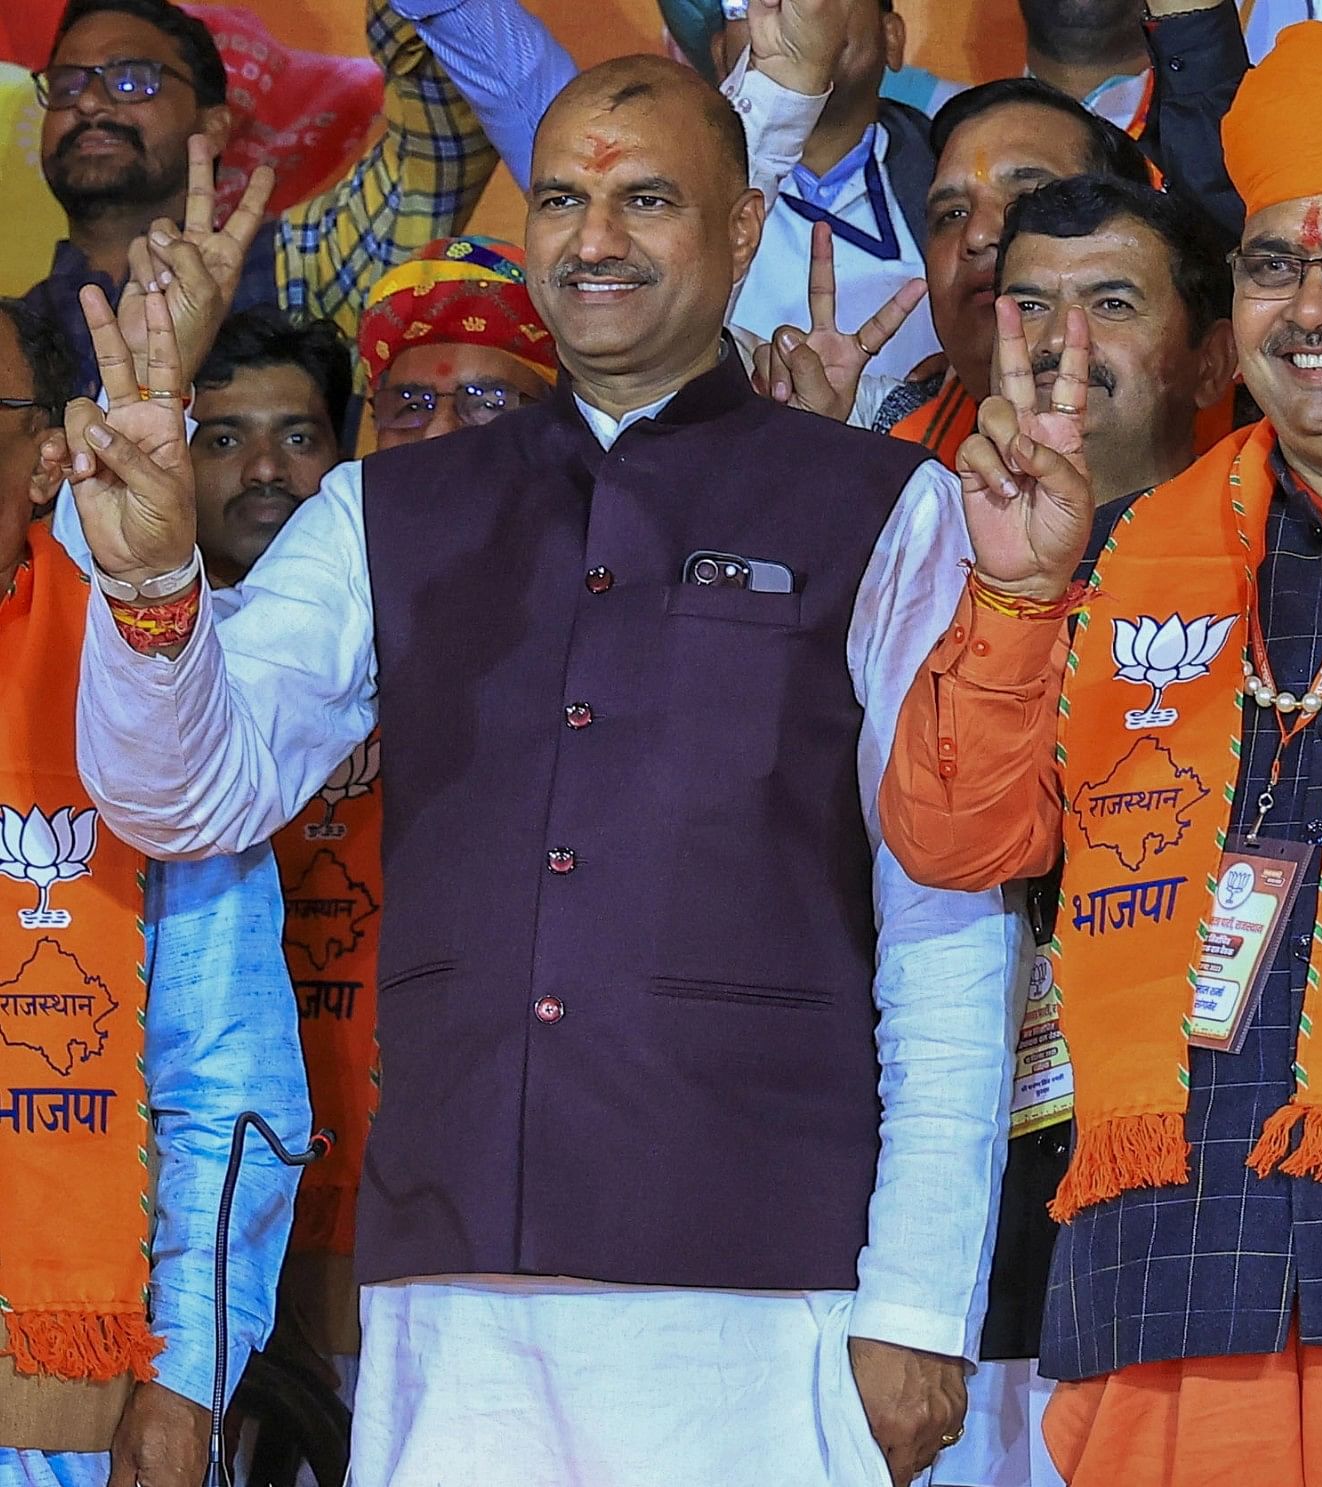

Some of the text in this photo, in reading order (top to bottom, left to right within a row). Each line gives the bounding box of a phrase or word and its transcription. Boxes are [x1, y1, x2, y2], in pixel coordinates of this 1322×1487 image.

[1088, 788, 1184, 818] राजस्थान
[1072, 876, 1189, 937] भाजपा
[0, 994, 96, 1017] राजस्थान
[296, 981, 364, 1020] जपा
